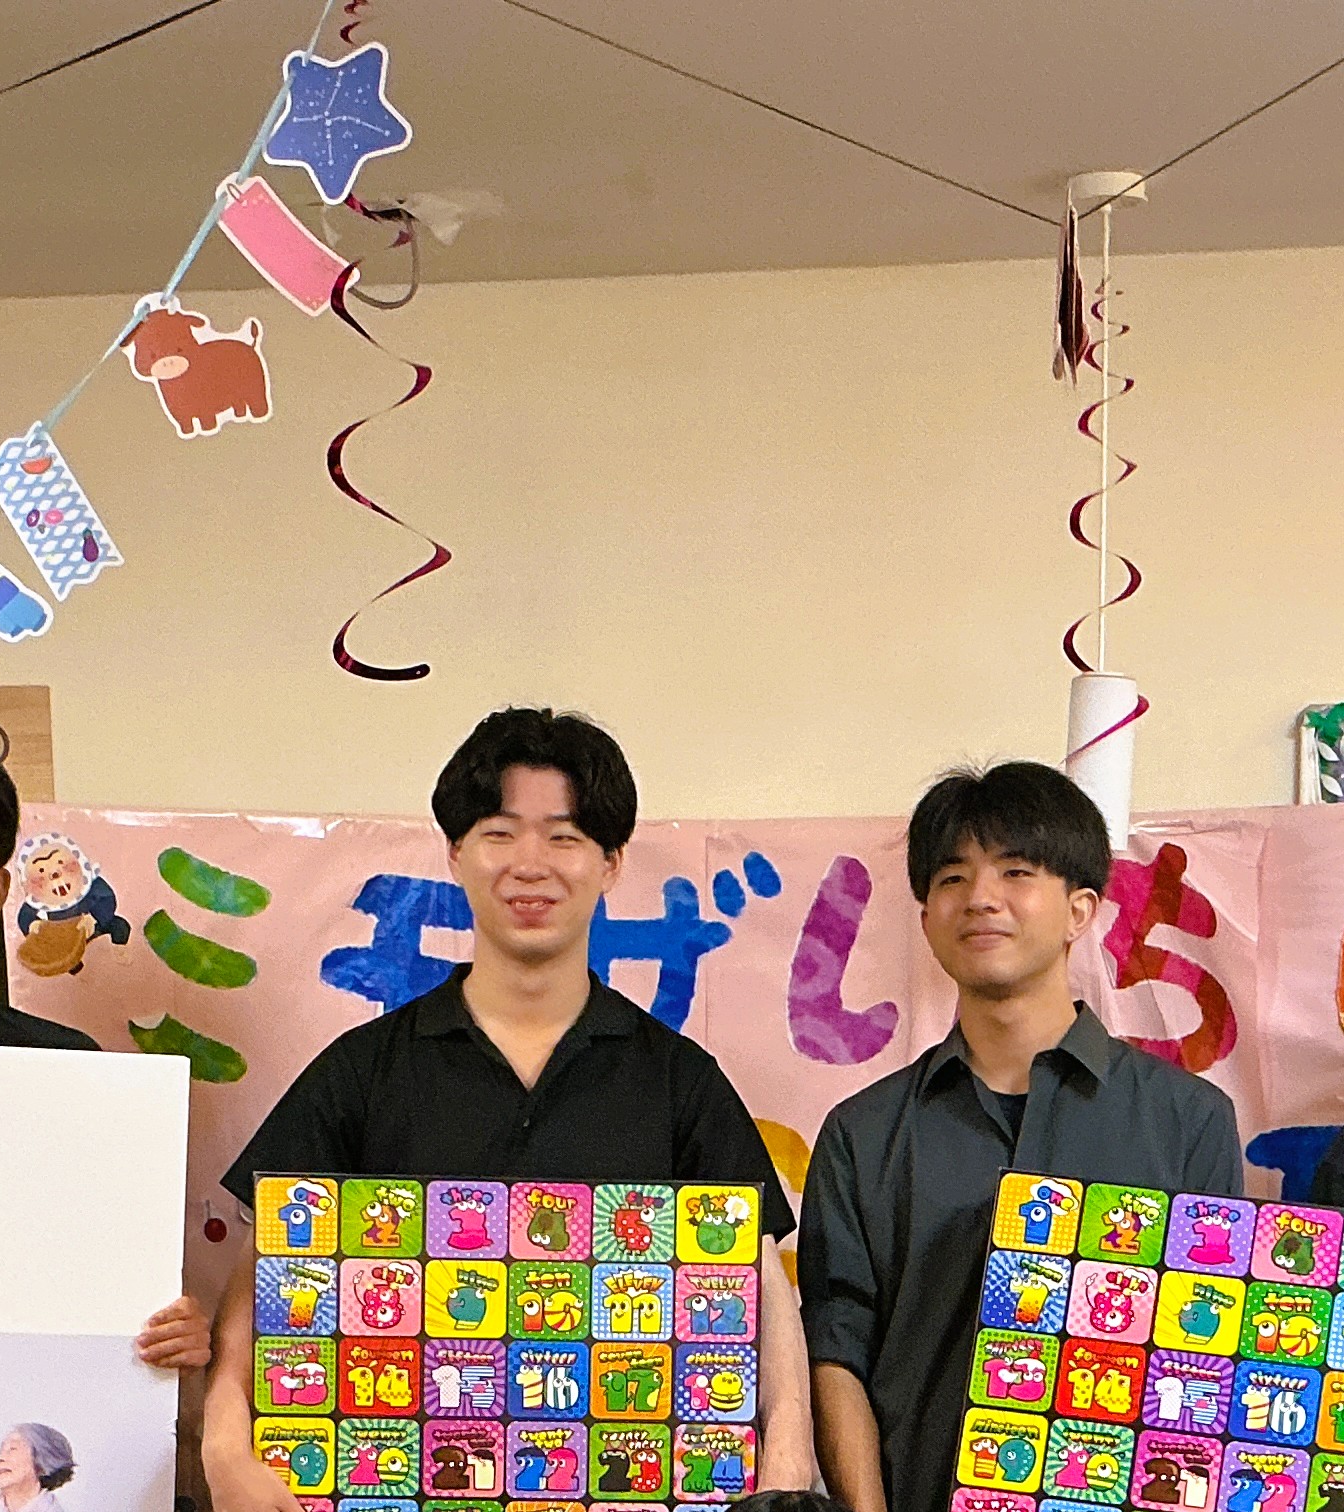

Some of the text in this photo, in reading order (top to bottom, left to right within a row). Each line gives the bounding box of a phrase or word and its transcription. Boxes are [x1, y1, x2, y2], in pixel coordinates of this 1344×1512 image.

[526, 1188, 577, 1211] four
[279, 1203, 312, 1247] 1
[362, 1200, 401, 1248] 2
[615, 1207, 653, 1251] 5
[1019, 1201, 1052, 1244] 1
[1099, 1206, 1140, 1254] 2
[1275, 1211, 1328, 1236] four
[525, 1271, 572, 1289] ten
[603, 1274, 666, 1294] ELEVEN
[686, 1275, 747, 1290] TWELVE
[1010, 1276, 1049, 1324] 7
[279, 1283, 319, 1328] 7
[362, 1284, 402, 1329] 8
[517, 1291, 583, 1332] 10
[604, 1293, 662, 1334] 11
[684, 1292, 748, 1335] 12
[1090, 1288, 1135, 1333] 8
[1264, 1293, 1313, 1313] ten
[1252, 1312, 1322, 1357] 10
[348, 1365, 413, 1407] 14
[432, 1365, 495, 1408] 15
[516, 1364, 579, 1410] 16
[600, 1370, 664, 1412] 17
[1068, 1367, 1132, 1414] 14
[1155, 1376, 1221, 1425] 15
[1241, 1385, 1307, 1434] 16
[349, 1444, 410, 1485] 20
[432, 1445, 495, 1490] 21
[514, 1448, 579, 1491] 22
[599, 1450, 662, 1493] 23
[681, 1449, 744, 1494] 24
[970, 1437, 1037, 1483] 19
[1056, 1446, 1120, 1491] 20
[1142, 1457, 1210, 1508] 21
